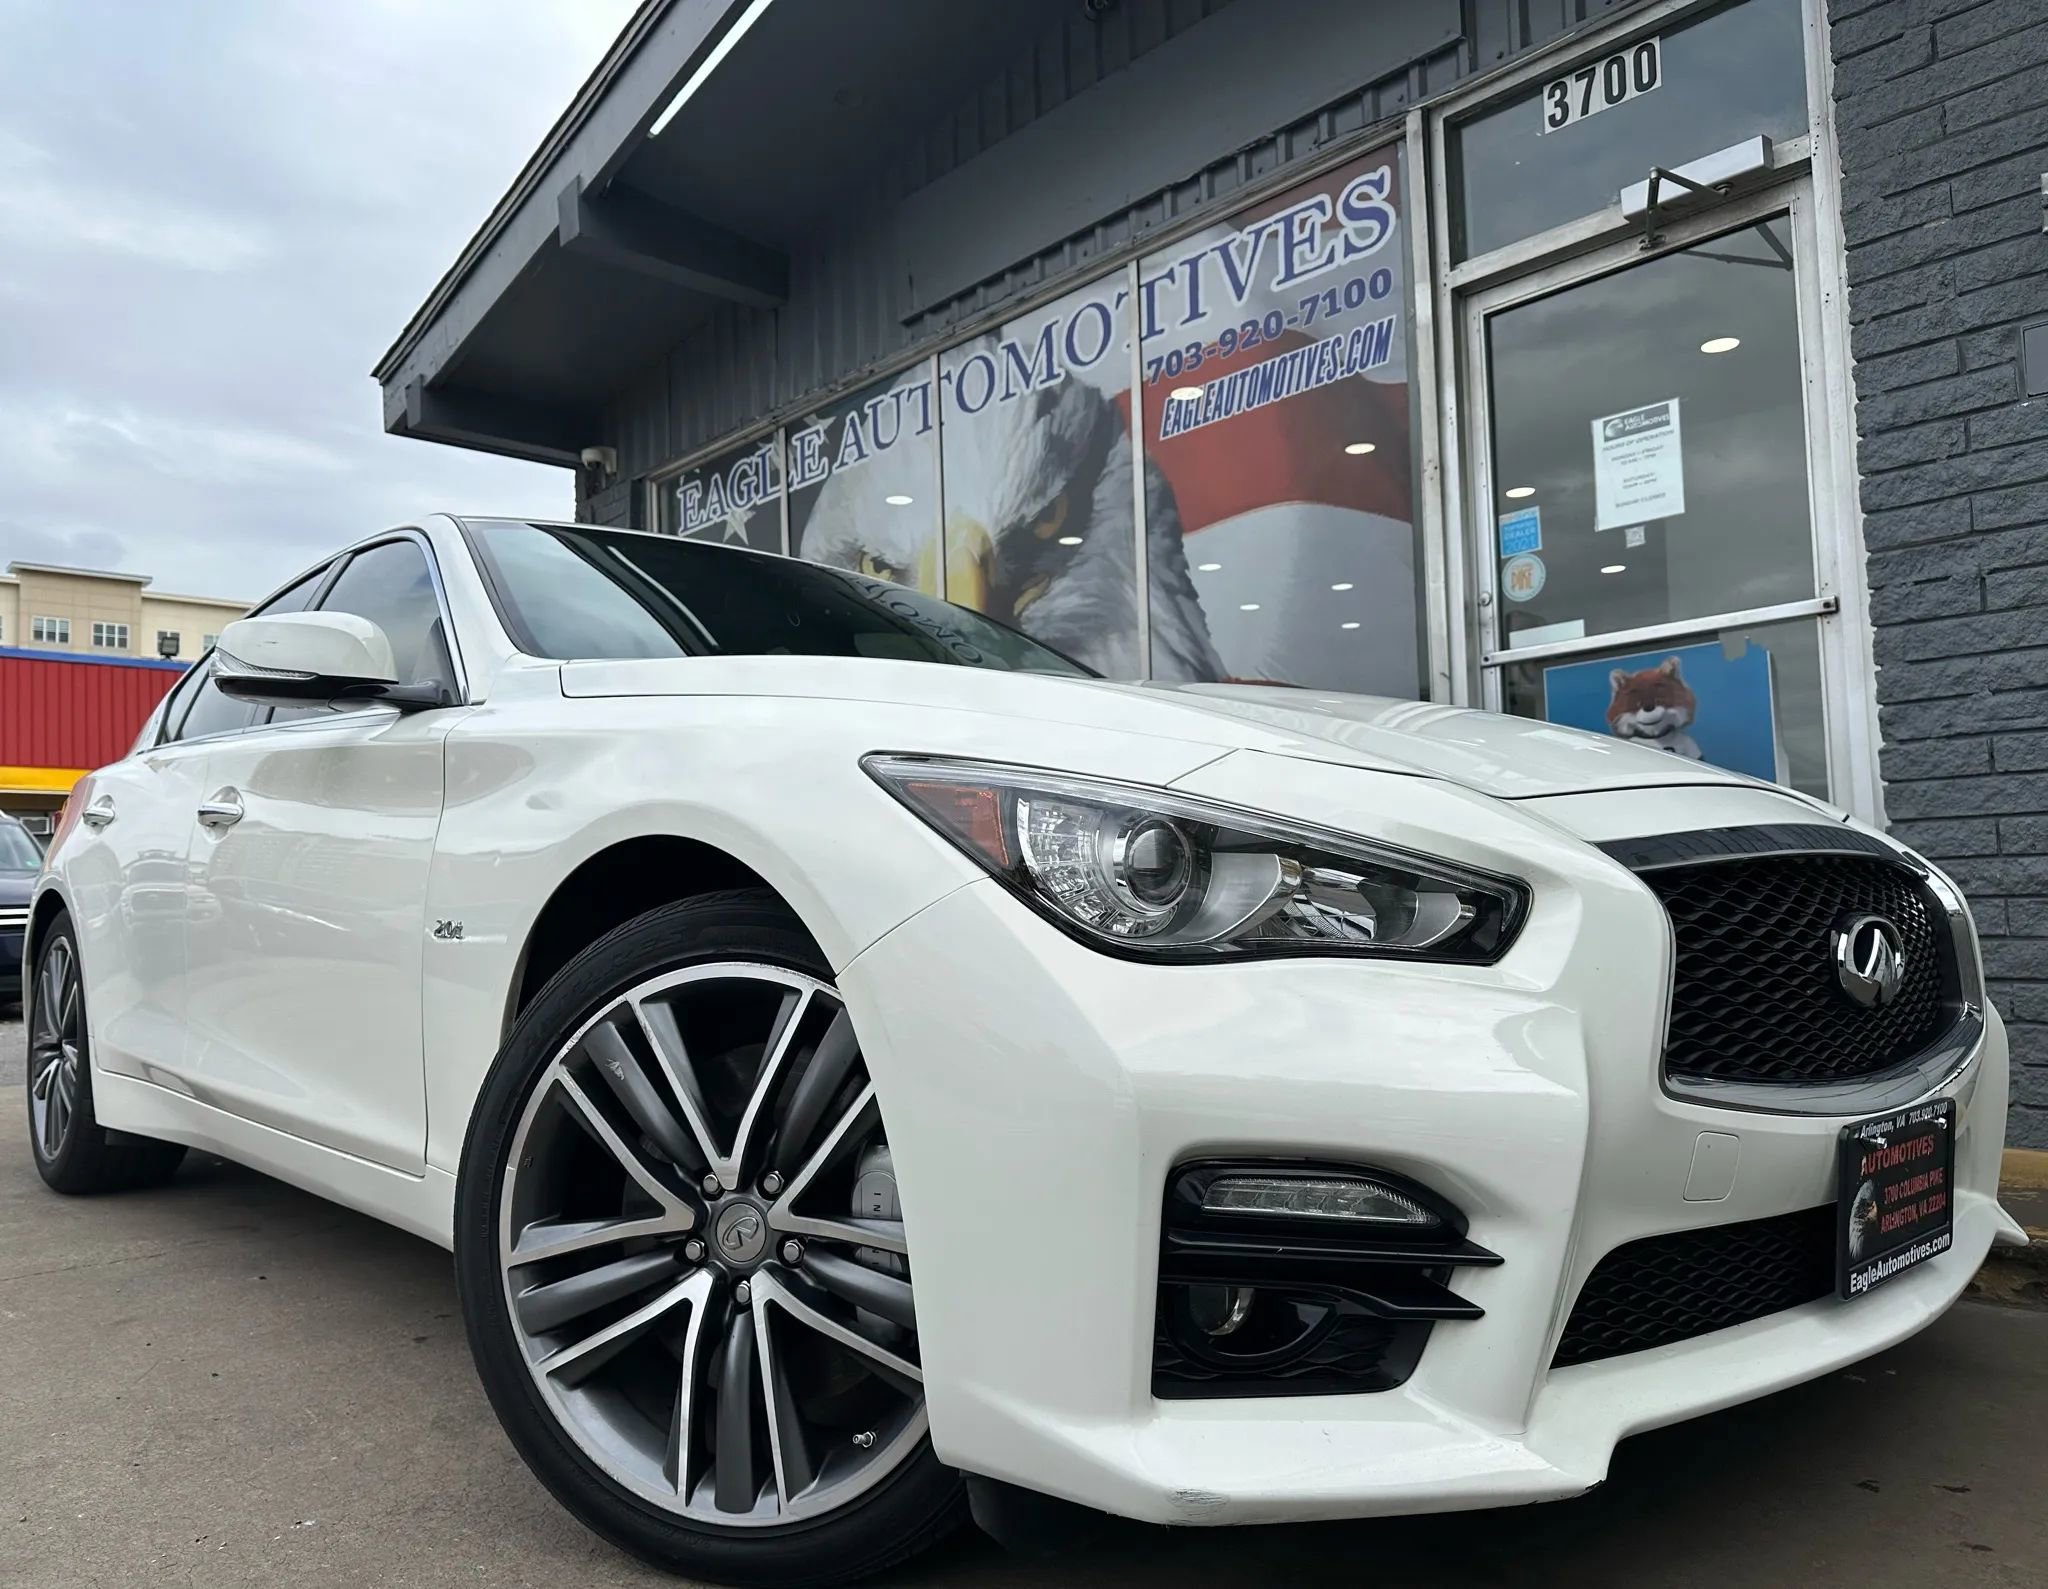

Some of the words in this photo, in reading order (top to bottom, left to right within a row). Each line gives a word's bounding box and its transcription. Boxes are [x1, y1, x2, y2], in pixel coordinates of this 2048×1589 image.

[1547, 42, 1658, 128] 3700
[676, 426, 829, 535] EAGLE
[833, 165, 1396, 472] AUTOMOTIVES
[1147, 268, 1393, 385] 703-920-7100
[1160, 315, 1397, 440] EAGLEAUTOMOTIVES.COM
[1860, 1134, 1935, 1176] AUTOMOTIVES
[1850, 1232, 1950, 1293] EagleAutomotives.com
